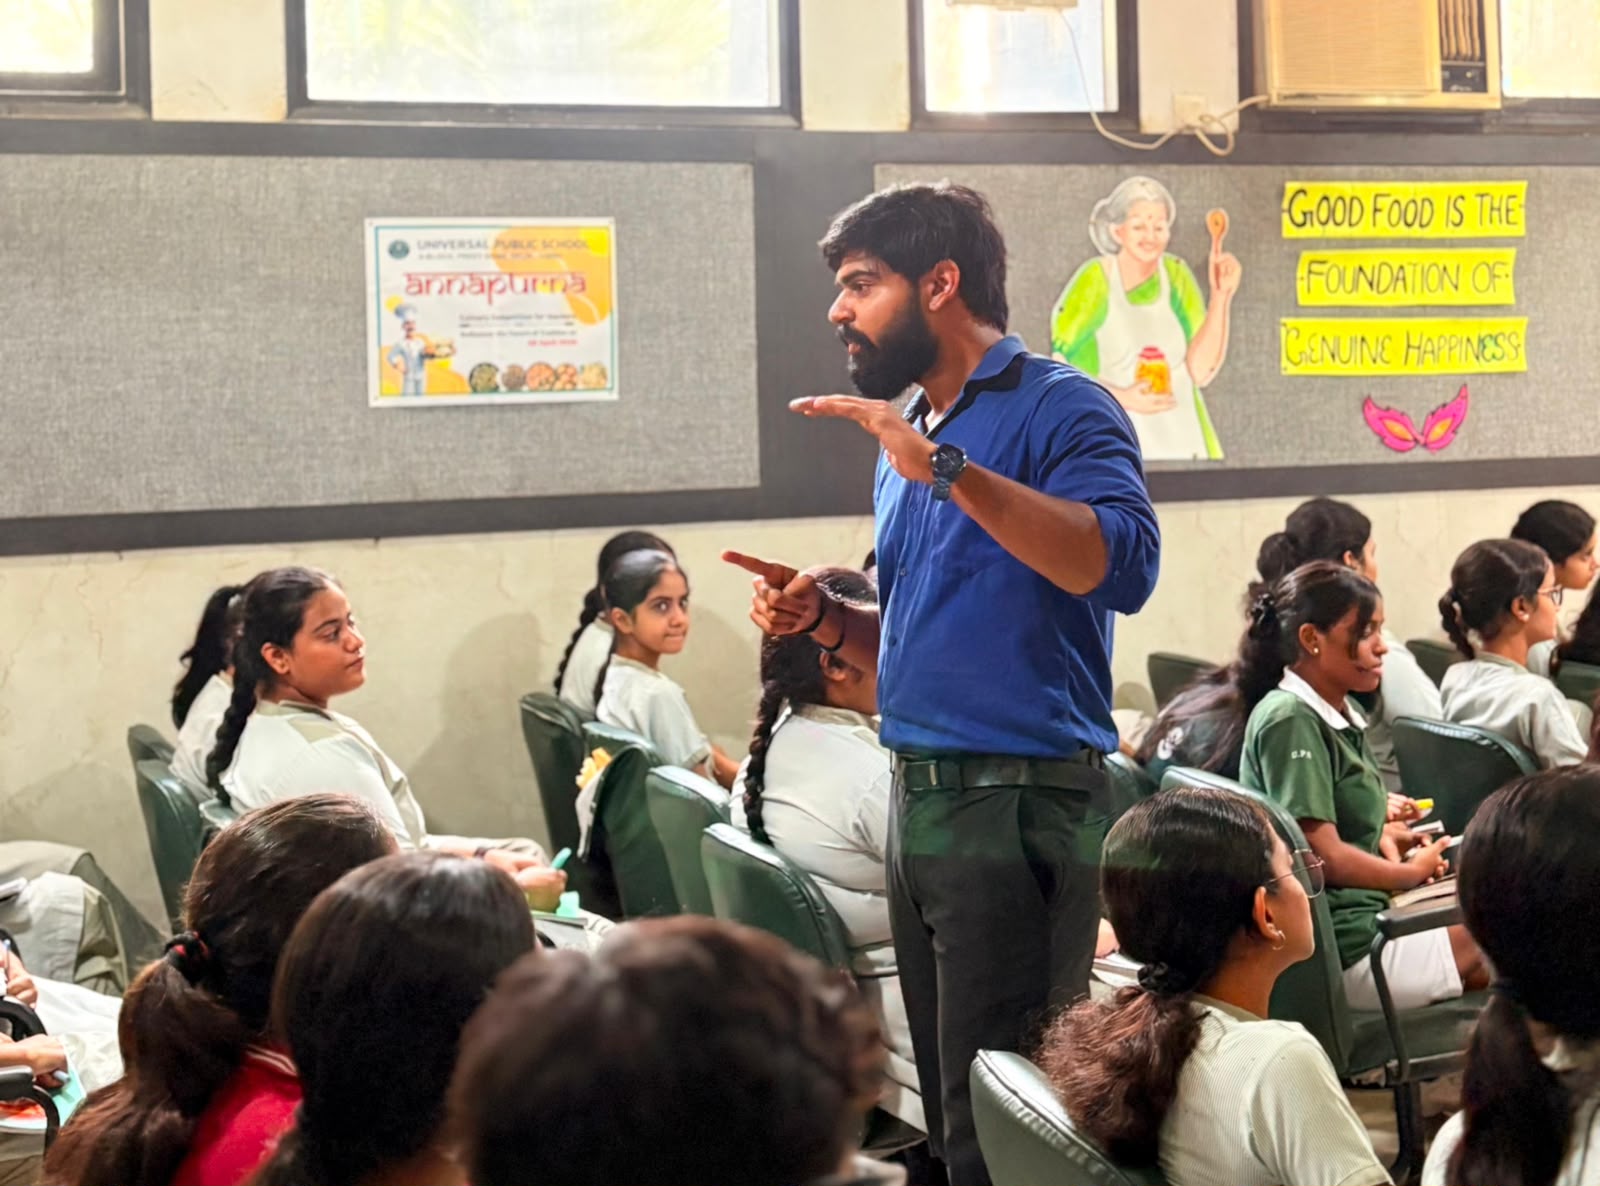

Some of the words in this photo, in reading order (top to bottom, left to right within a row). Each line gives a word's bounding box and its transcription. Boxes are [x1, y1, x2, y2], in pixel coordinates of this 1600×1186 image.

[1288, 189, 1364, 228] GOOD
[1372, 193, 1435, 228] FOOD
[1445, 195, 1466, 228] IS
[1475, 193, 1518, 226] THE
[417, 239, 489, 250] UNIVERSAL
[1307, 260, 1460, 295] FOUNDATION
[1472, 261, 1508, 293] OF
[1285, 327, 1392, 366] GENUINE
[1404, 330, 1521, 366] HAPPINESS
